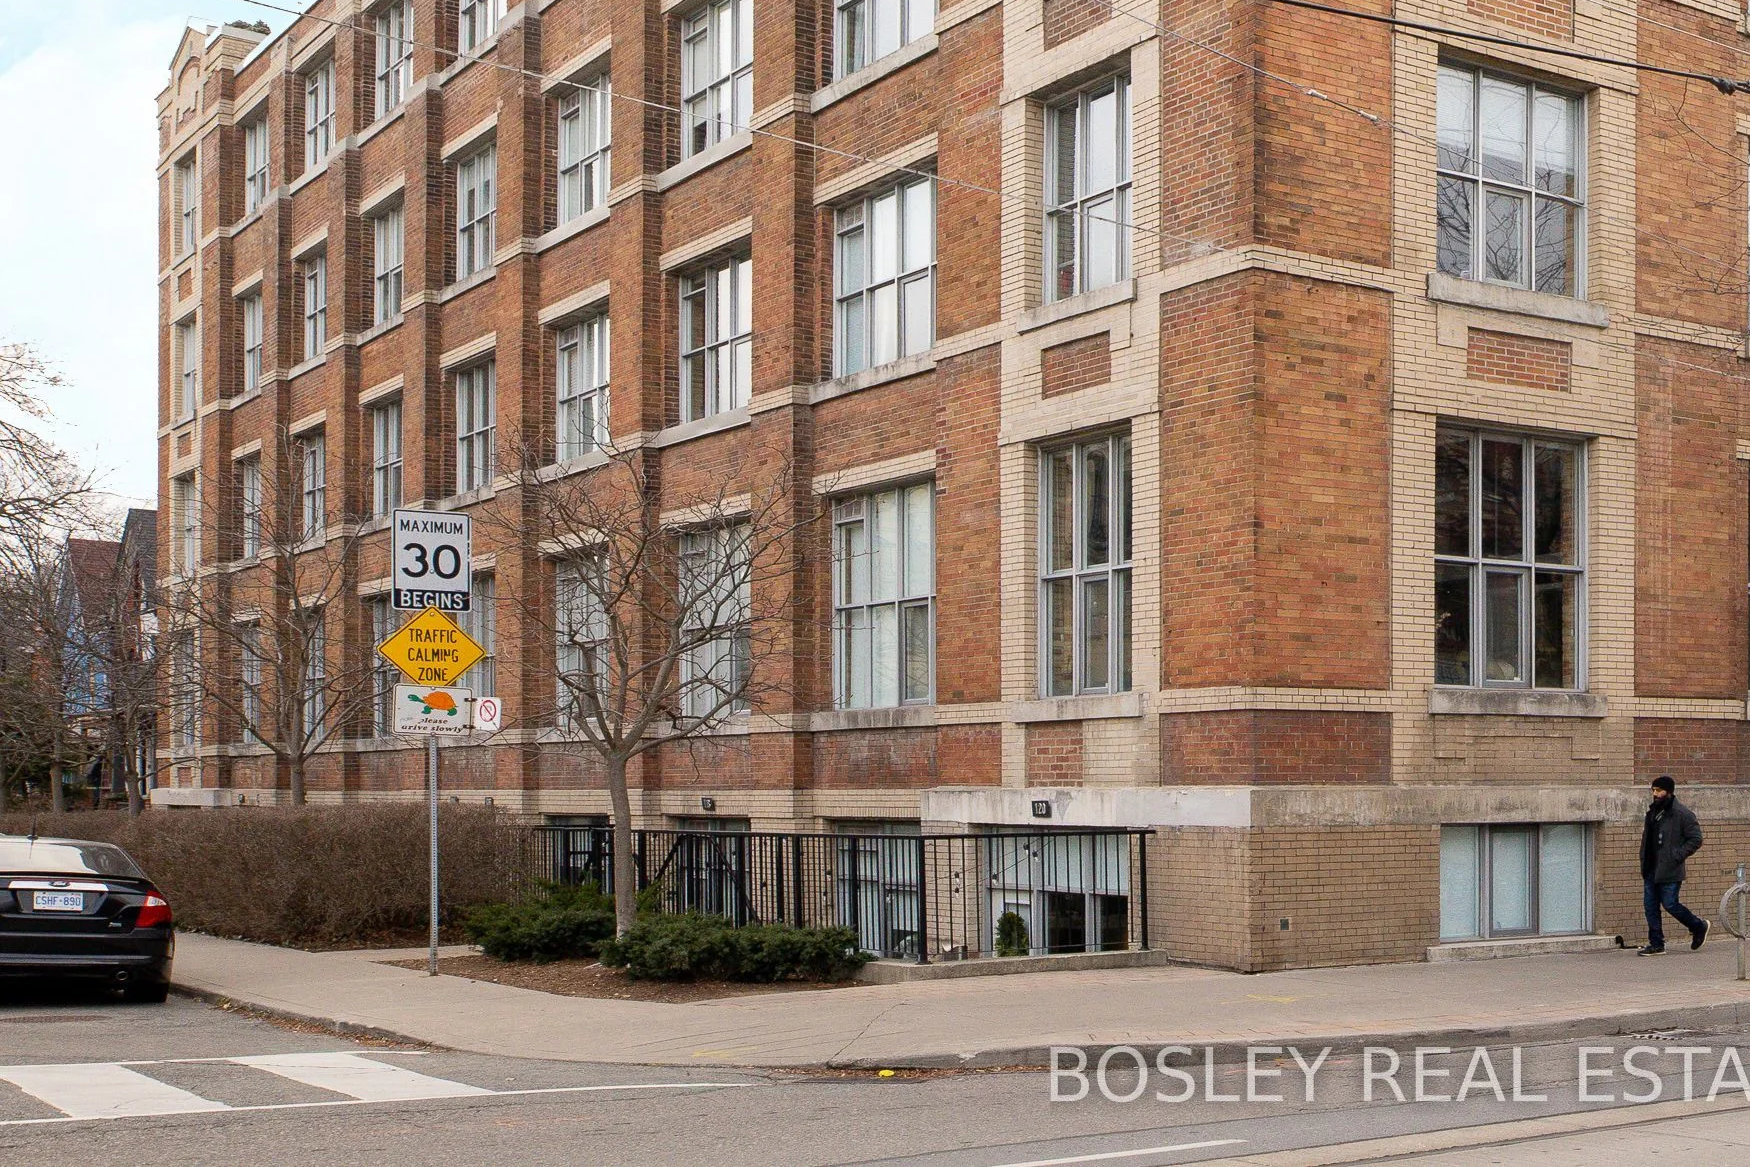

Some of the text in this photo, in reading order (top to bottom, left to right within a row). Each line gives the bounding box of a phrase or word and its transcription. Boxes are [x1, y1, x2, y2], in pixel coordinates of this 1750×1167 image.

[400, 519, 463, 535] MAXIMUM
[401, 542, 461, 579] 30
[400, 591, 464, 609] BEGINS
[408, 628, 457, 644] TRAFFIC
[408, 647, 459, 663] CALMING
[418, 667, 448, 682] ZONE
[431, 726, 463, 734] slowly
[1034, 802, 1046, 814] 120
